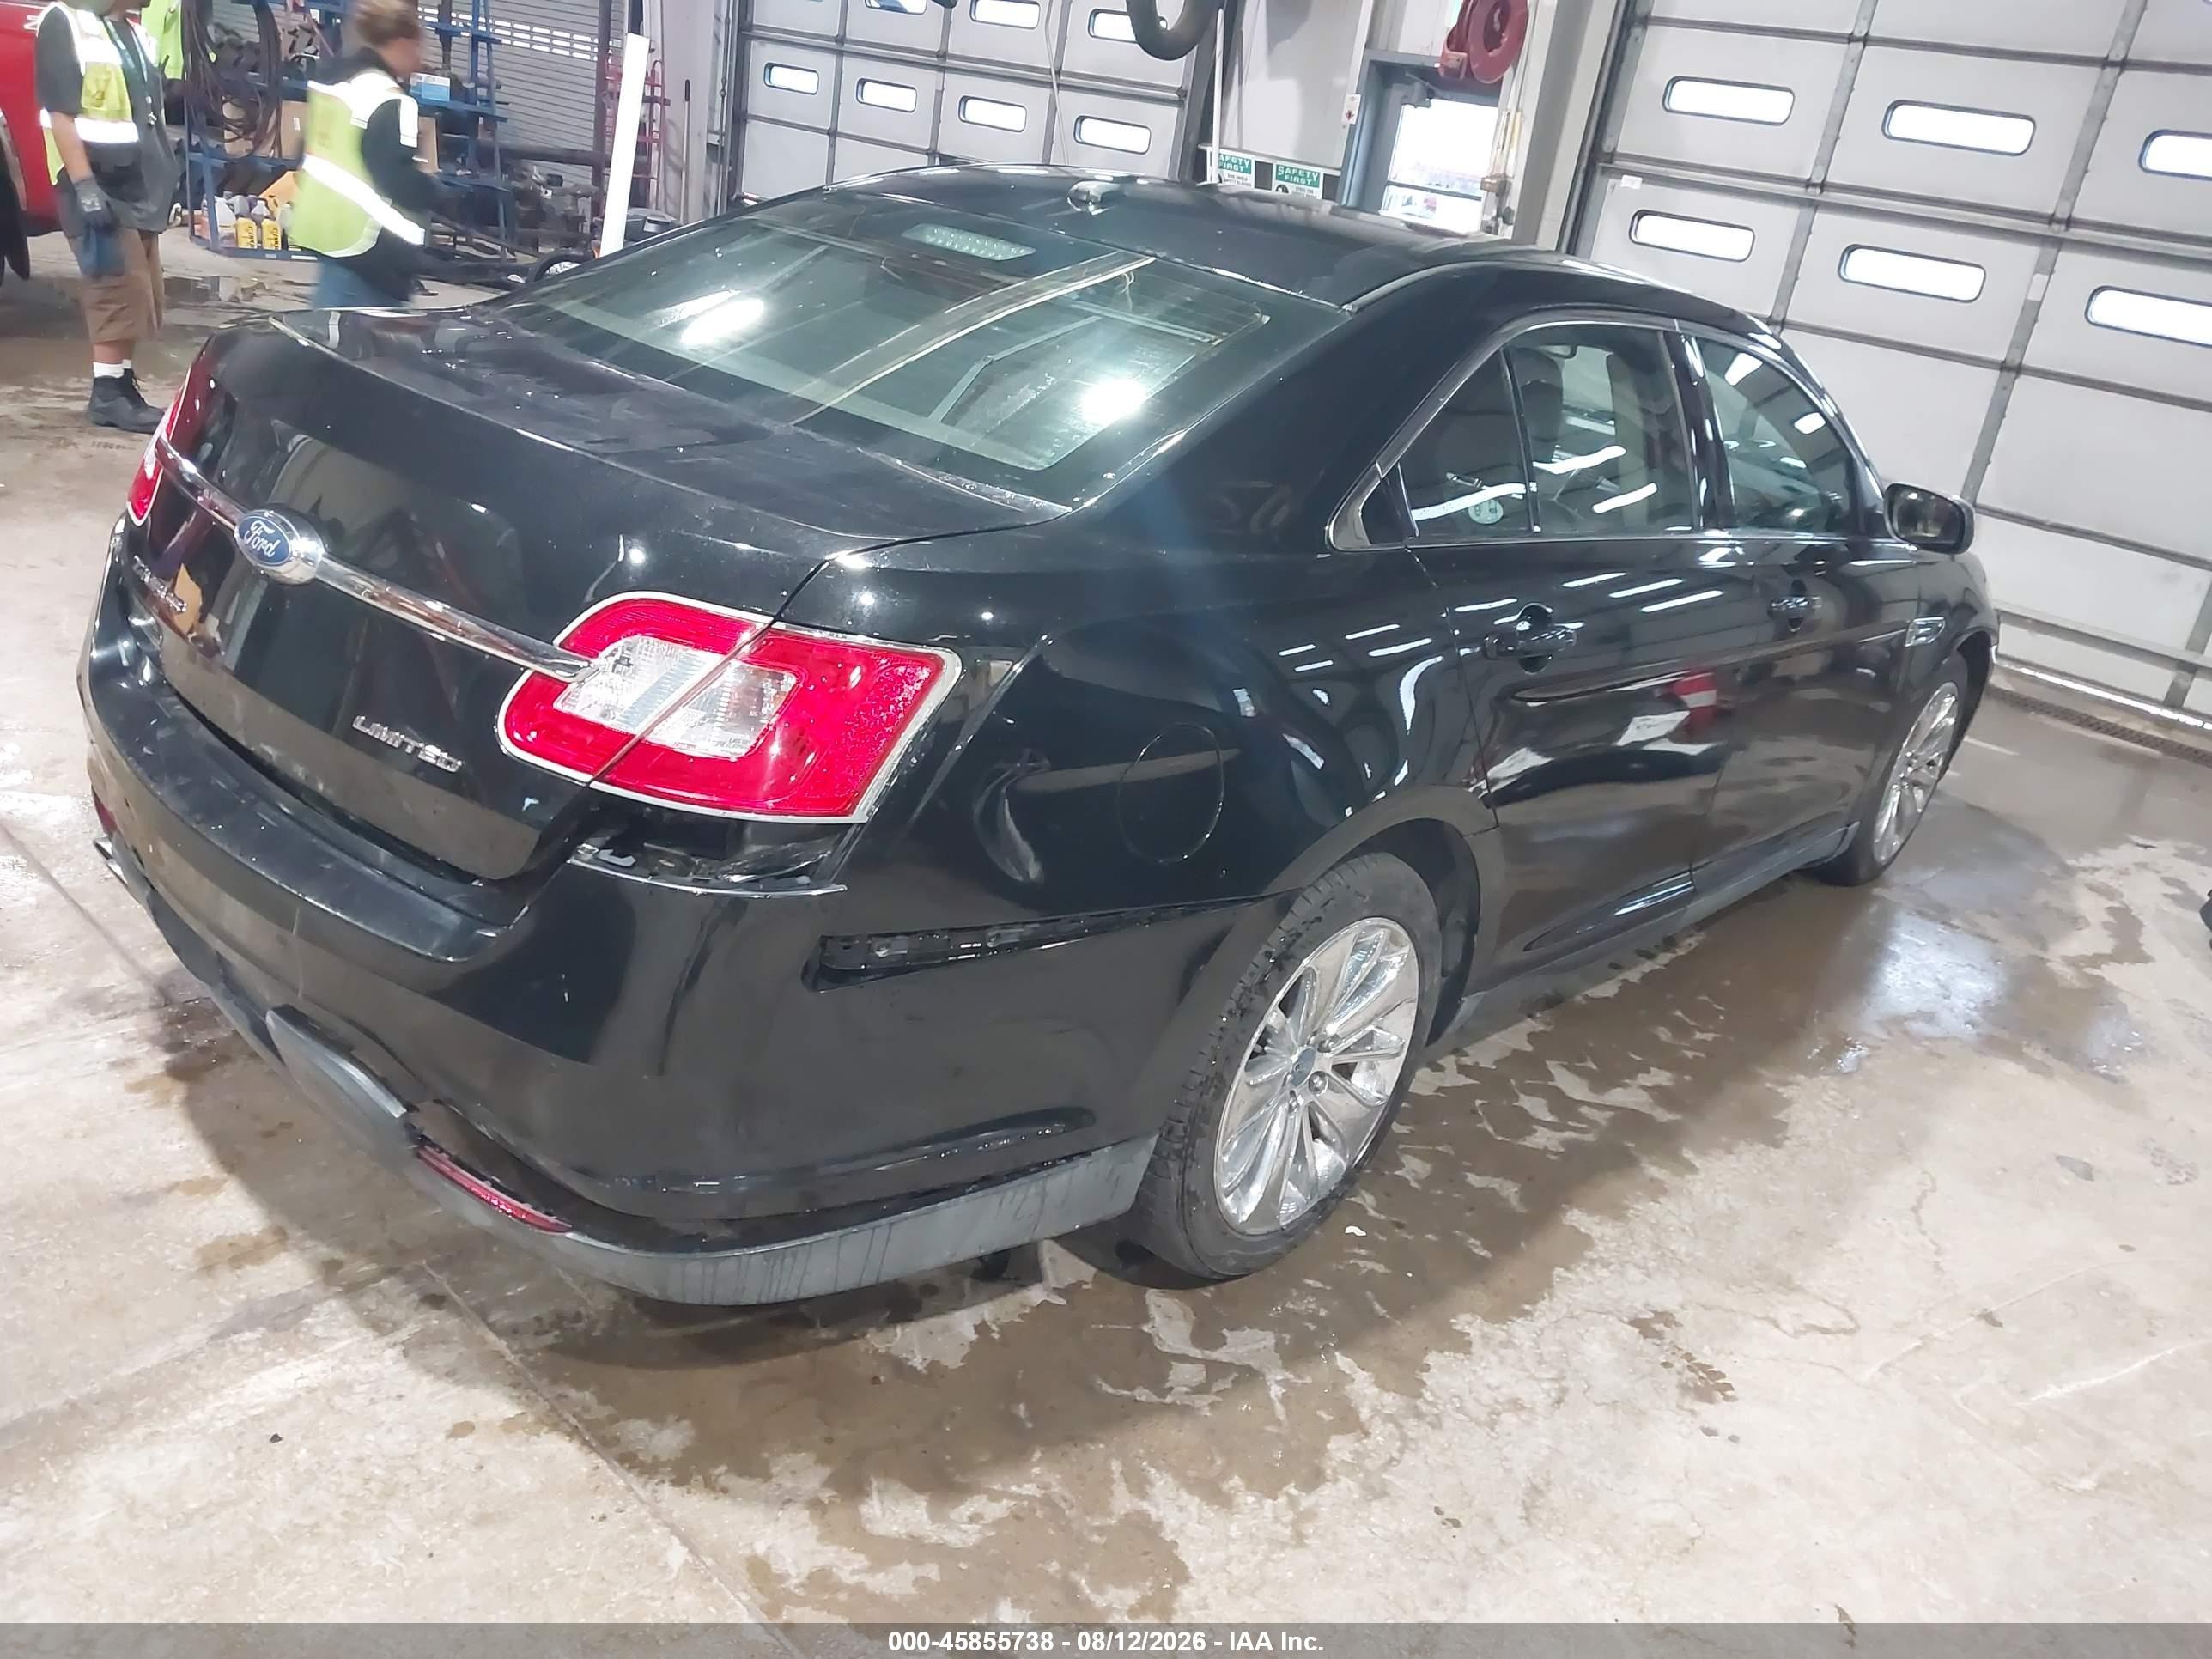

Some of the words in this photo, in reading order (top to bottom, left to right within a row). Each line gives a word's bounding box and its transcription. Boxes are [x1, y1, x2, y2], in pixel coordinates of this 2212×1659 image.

[1218, 155, 1250, 168] AFETY
[1278, 166, 1318, 181] SAFETY
[1284, 174, 1312, 185] FIRST
[244, 520, 281, 558] Ford
[352, 715, 463, 773] LIMITED
